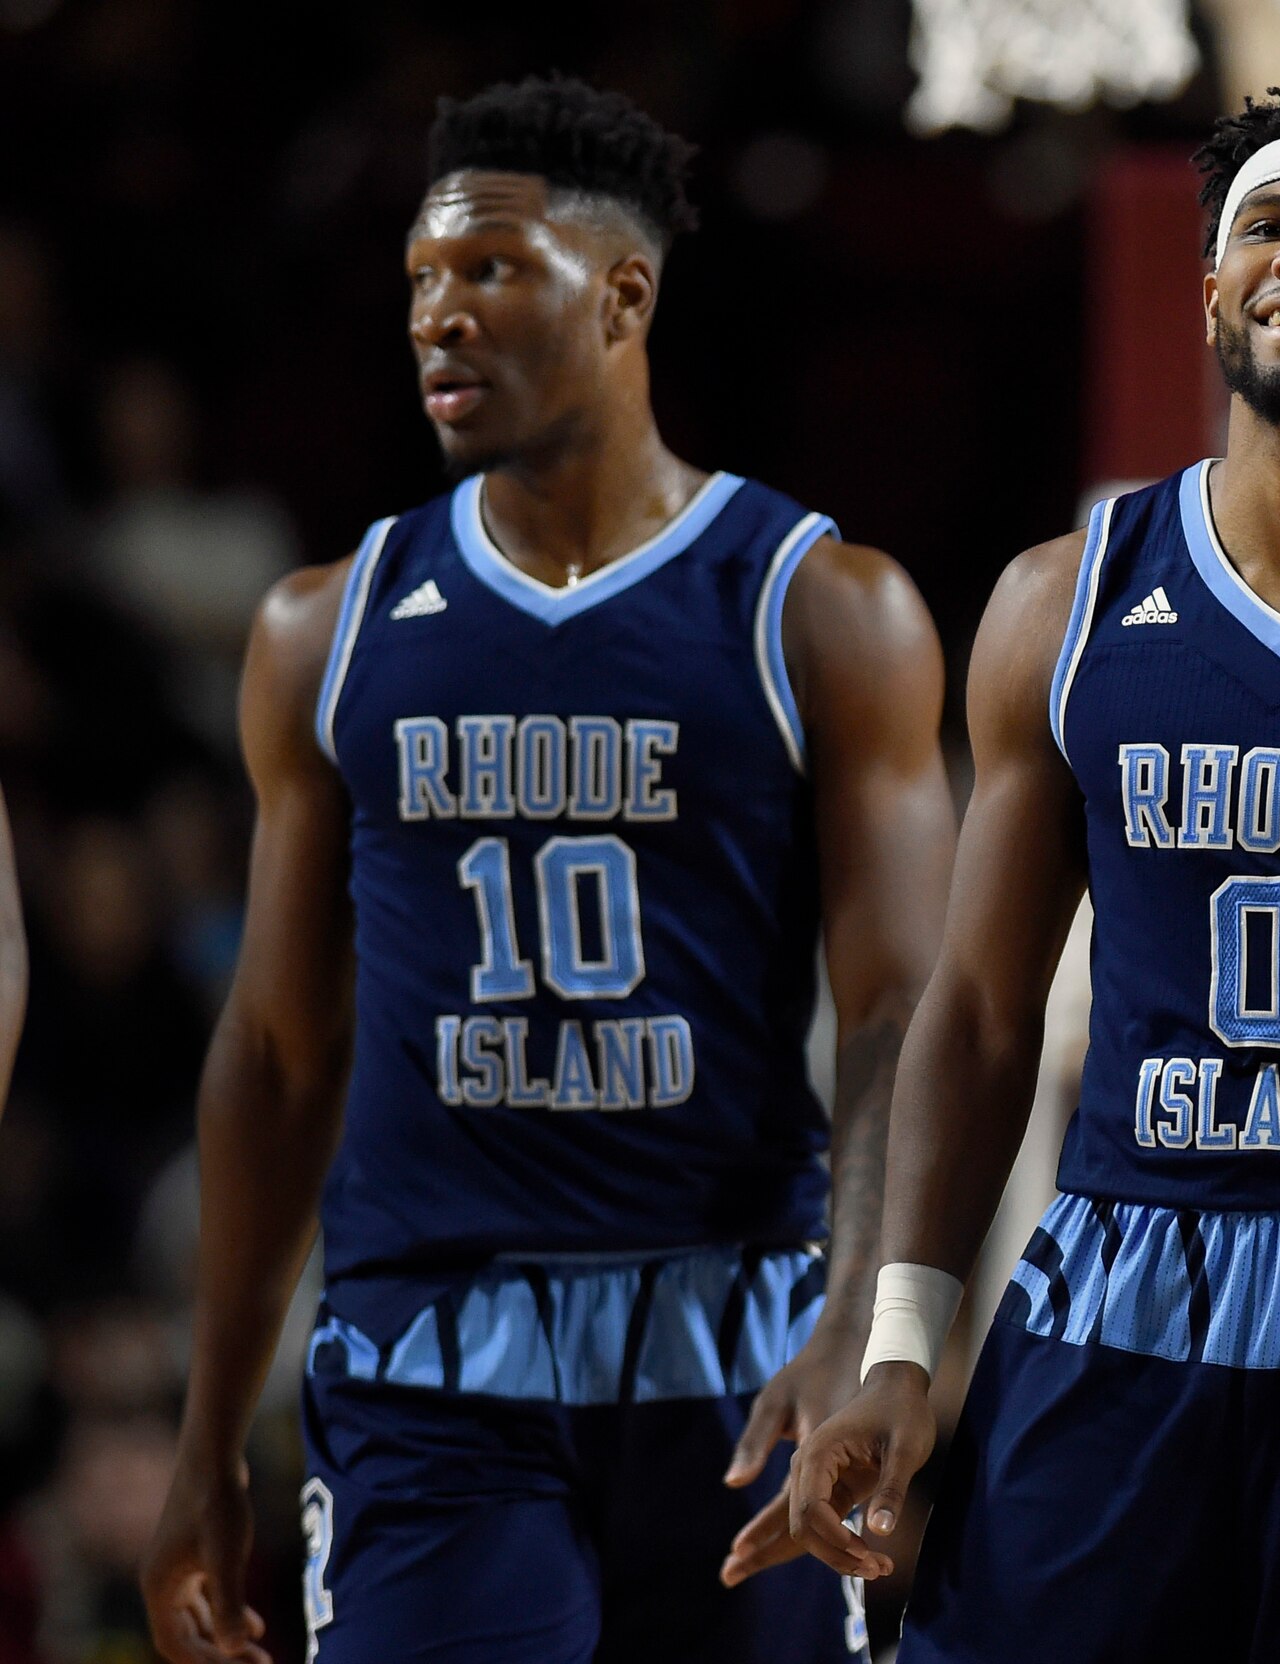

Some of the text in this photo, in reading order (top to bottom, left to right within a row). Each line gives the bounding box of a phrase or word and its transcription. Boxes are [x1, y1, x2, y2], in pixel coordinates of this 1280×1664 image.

[1121, 610, 1178, 626] adidas
[393, 714, 679, 821] RHODE
[457, 833, 646, 1003] 10
[435, 1013, 695, 1111] ISLAND
